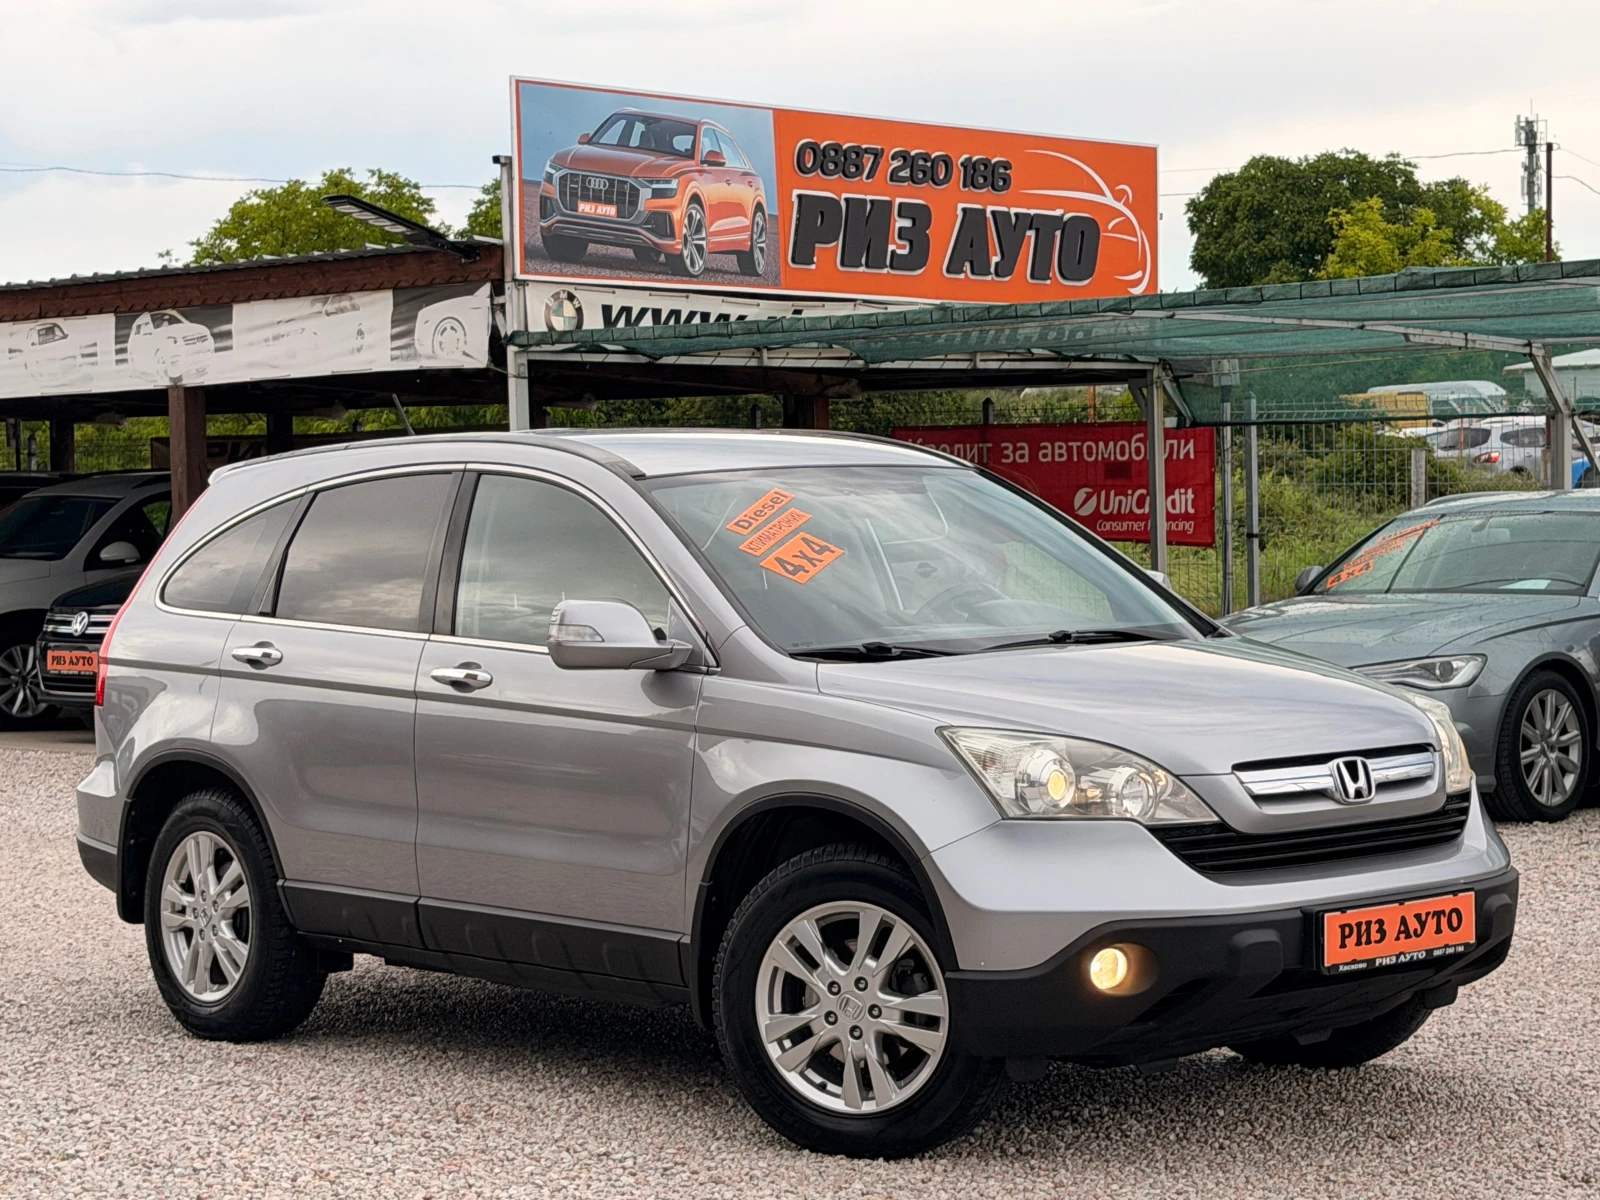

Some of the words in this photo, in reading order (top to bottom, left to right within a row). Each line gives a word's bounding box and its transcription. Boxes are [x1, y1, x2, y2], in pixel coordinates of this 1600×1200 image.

[795, 138, 884, 182] 0887
[887, 148, 953, 189] 260
[958, 154, 1013, 193] 186
[579, 203, 595, 213] РИЗ
[596, 205, 616, 216] АУТО
[789, 189, 932, 275] РИЗ
[943, 203, 1101, 287] АУТО
[1001, 441, 1029, 464] за
[1038, 433, 1194, 463] автомобли
[734, 491, 789, 531] Diesel
[1100, 488, 1195, 515] UniCrdit
[1096, 519, 1146, 532] Consumer
[68, 656, 94, 667] АУТО
[1338, 918, 1387, 949] РИЗ
[1394, 908, 1463, 941] АУТО
[1375, 955, 1396, 966] РИЗ
[1398, 951, 1426, 963] АУТО
